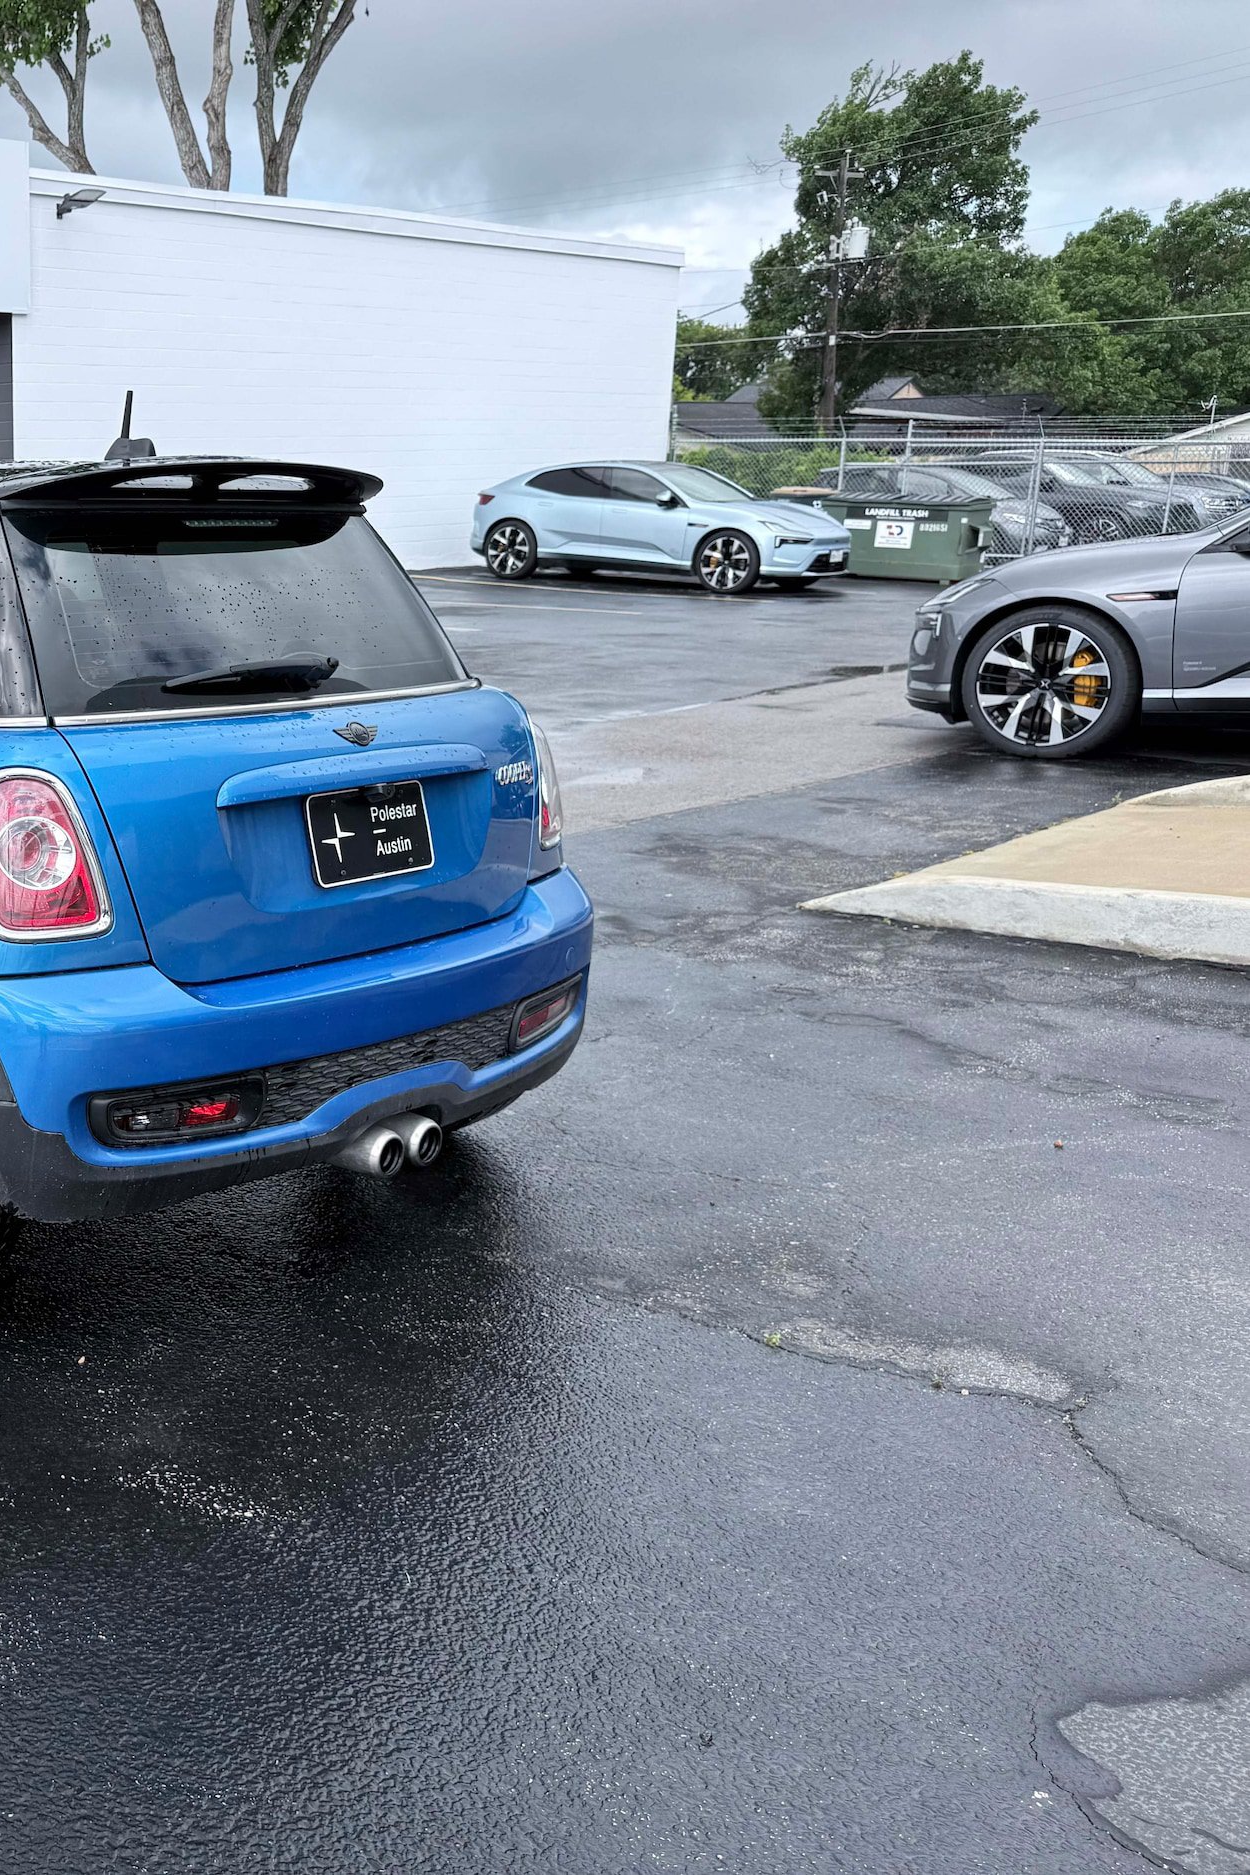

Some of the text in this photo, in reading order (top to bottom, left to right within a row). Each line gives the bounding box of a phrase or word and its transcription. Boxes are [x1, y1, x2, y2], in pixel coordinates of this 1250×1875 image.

[864, 508, 929, 518] LANDFILL TRASH
[370, 802, 417, 822] Polestar
[376, 836, 412, 856] Austin
